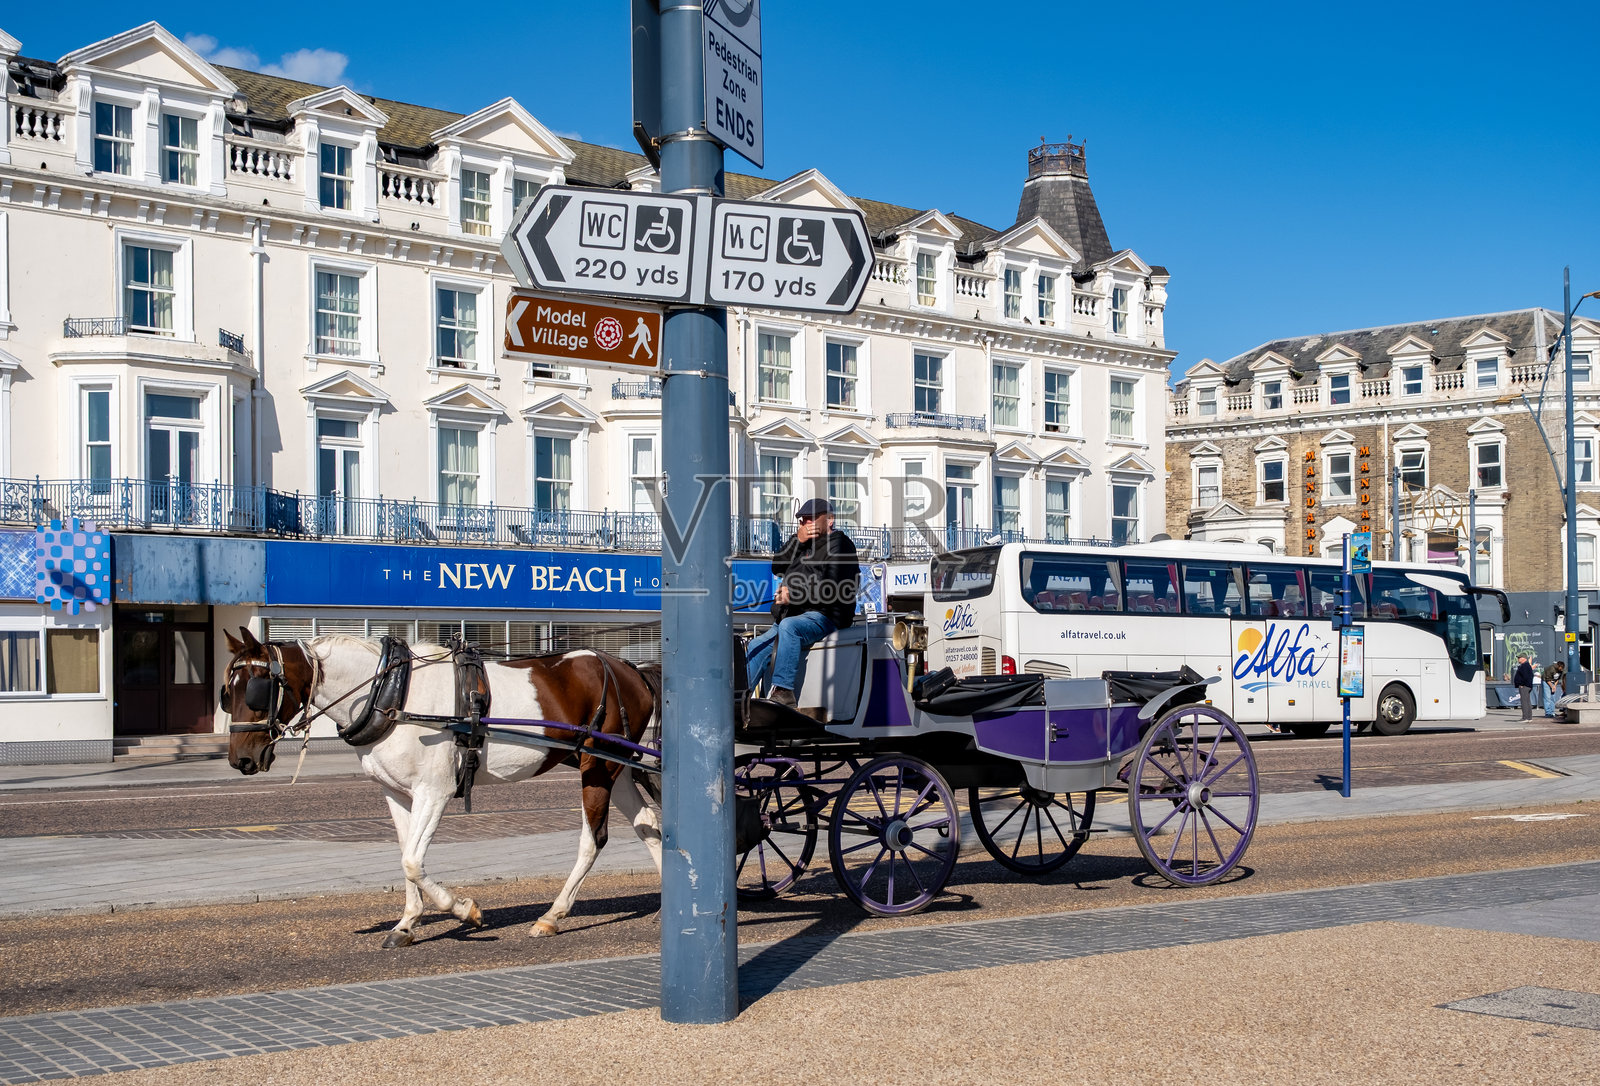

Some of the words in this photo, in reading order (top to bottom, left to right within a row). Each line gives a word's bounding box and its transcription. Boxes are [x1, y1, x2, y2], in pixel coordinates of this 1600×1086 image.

[709, 30, 758, 86] Pedestrian
[722, 68, 747, 103] Zone
[716, 97, 755, 148] ENDS
[587, 211, 622, 238] WC
[729, 223, 765, 250] WC
[575, 257, 627, 281] 220
[636, 265, 679, 287] yds
[722, 270, 765, 292] 170
[774, 277, 817, 298] yds
[536, 306, 587, 328] Model
[532, 326, 589, 351] Village
[1305, 451, 1316, 555] MANDARI
[1359, 446, 1371, 533] MANDAR
[383, 569, 432, 582] THE
[437, 563, 517, 591] NEW
[530, 565, 627, 593] BEACH
[895, 573, 919, 586] NEW
[943, 603, 976, 632] Alfa
[1060, 630, 1127, 640] alfatravel.co.uk
[945, 645, 979, 654] alfatravel.co.uk
[945, 654, 959, 662] 01257
[1233, 623, 1328, 682] Alfa
[1296, 680, 1332, 689] TRAVEL
